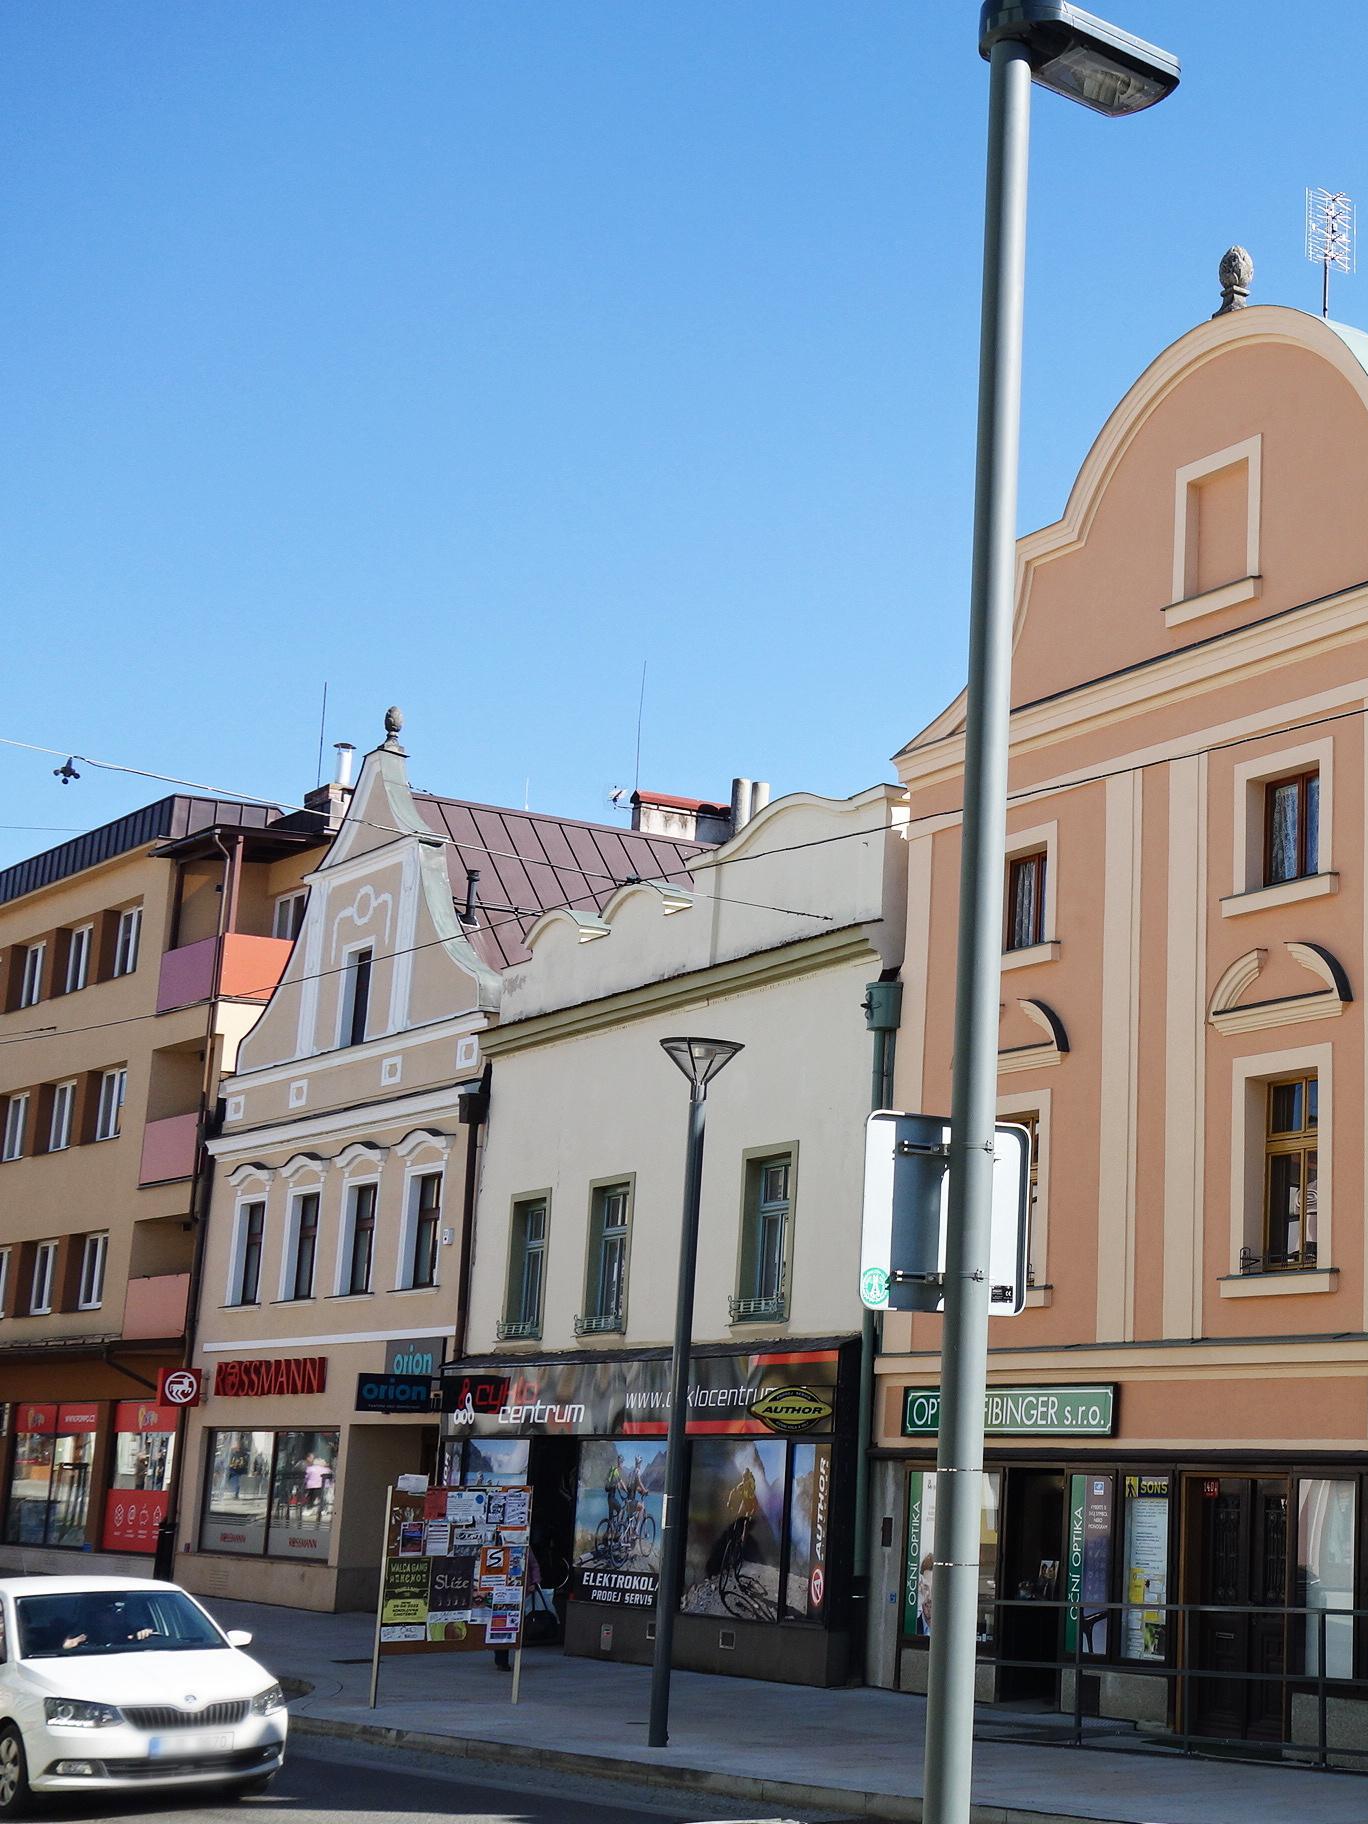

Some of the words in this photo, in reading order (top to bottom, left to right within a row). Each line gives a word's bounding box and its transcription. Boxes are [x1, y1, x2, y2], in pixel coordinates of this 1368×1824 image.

[393, 1344, 433, 1375] orion
[215, 1357, 326, 1396] ROSSMANN
[361, 1378, 427, 1401] orion
[499, 1400, 584, 1423] centrum
[761, 1406, 823, 1415] AUTHOR
[1063, 1404, 1104, 1425] s.r.o.
[1140, 1481, 1168, 1494] SONS
[815, 1456, 829, 1561] AUTHOR
[911, 1500, 921, 1557] OPTIKA
[1072, 1506, 1083, 1567] OPTIKA
[591, 1589, 621, 1603] PRODEJ
[624, 1592, 653, 1606] SERVIS
[906, 1562, 919, 1606] OČNÍ
[1068, 1573, 1080, 1620] OČNÍ
